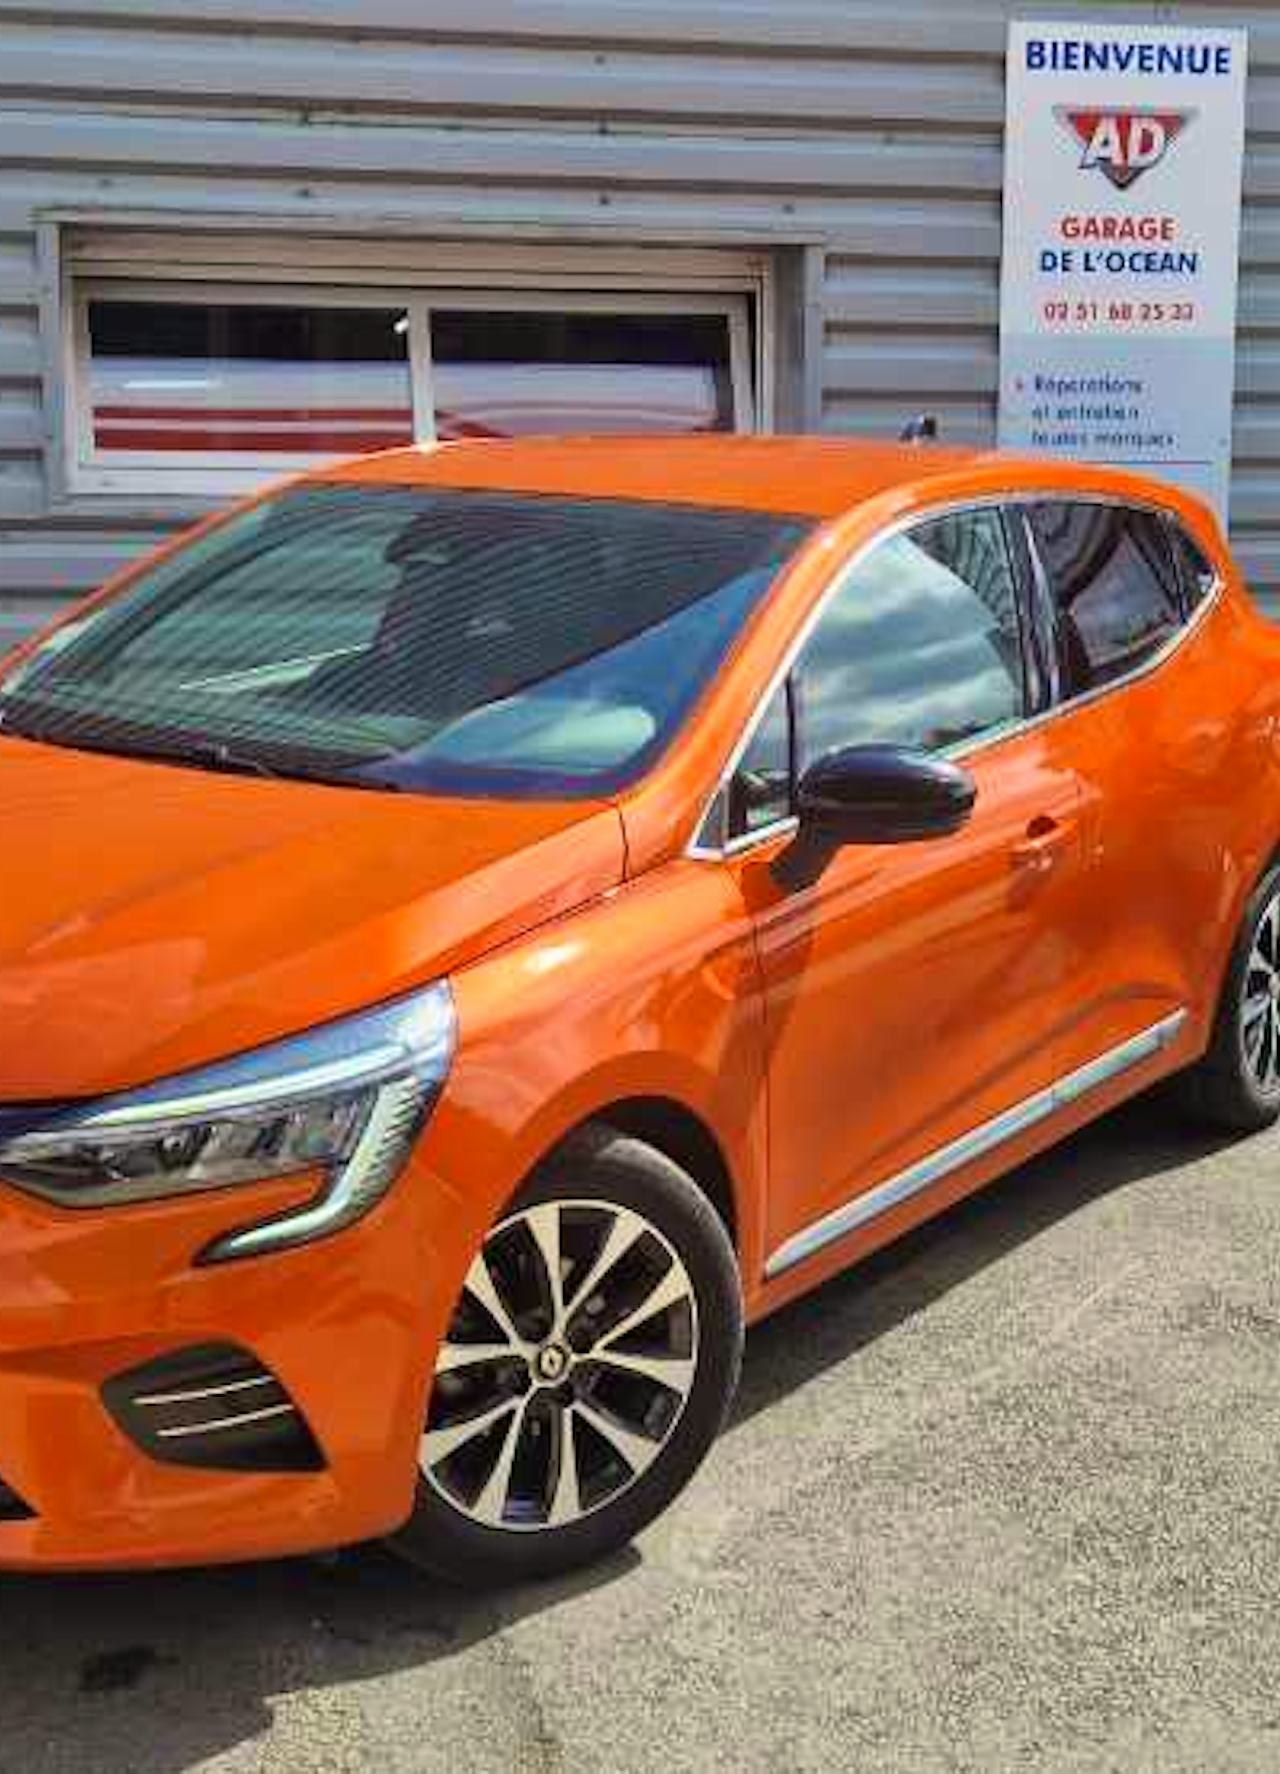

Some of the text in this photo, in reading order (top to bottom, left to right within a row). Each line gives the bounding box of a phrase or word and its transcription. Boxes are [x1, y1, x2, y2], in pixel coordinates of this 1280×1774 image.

[1025, 40, 1232, 75] BIENVENUE
[1077, 115, 1169, 170] AD
[1060, 216, 1176, 241] GARAGE
[1039, 251, 1200, 274] DE L'OCEAN
[1044, 302, 1069, 321] 02
[1076, 302, 1098, 321] 51
[1139, 302, 1164, 321] 25
